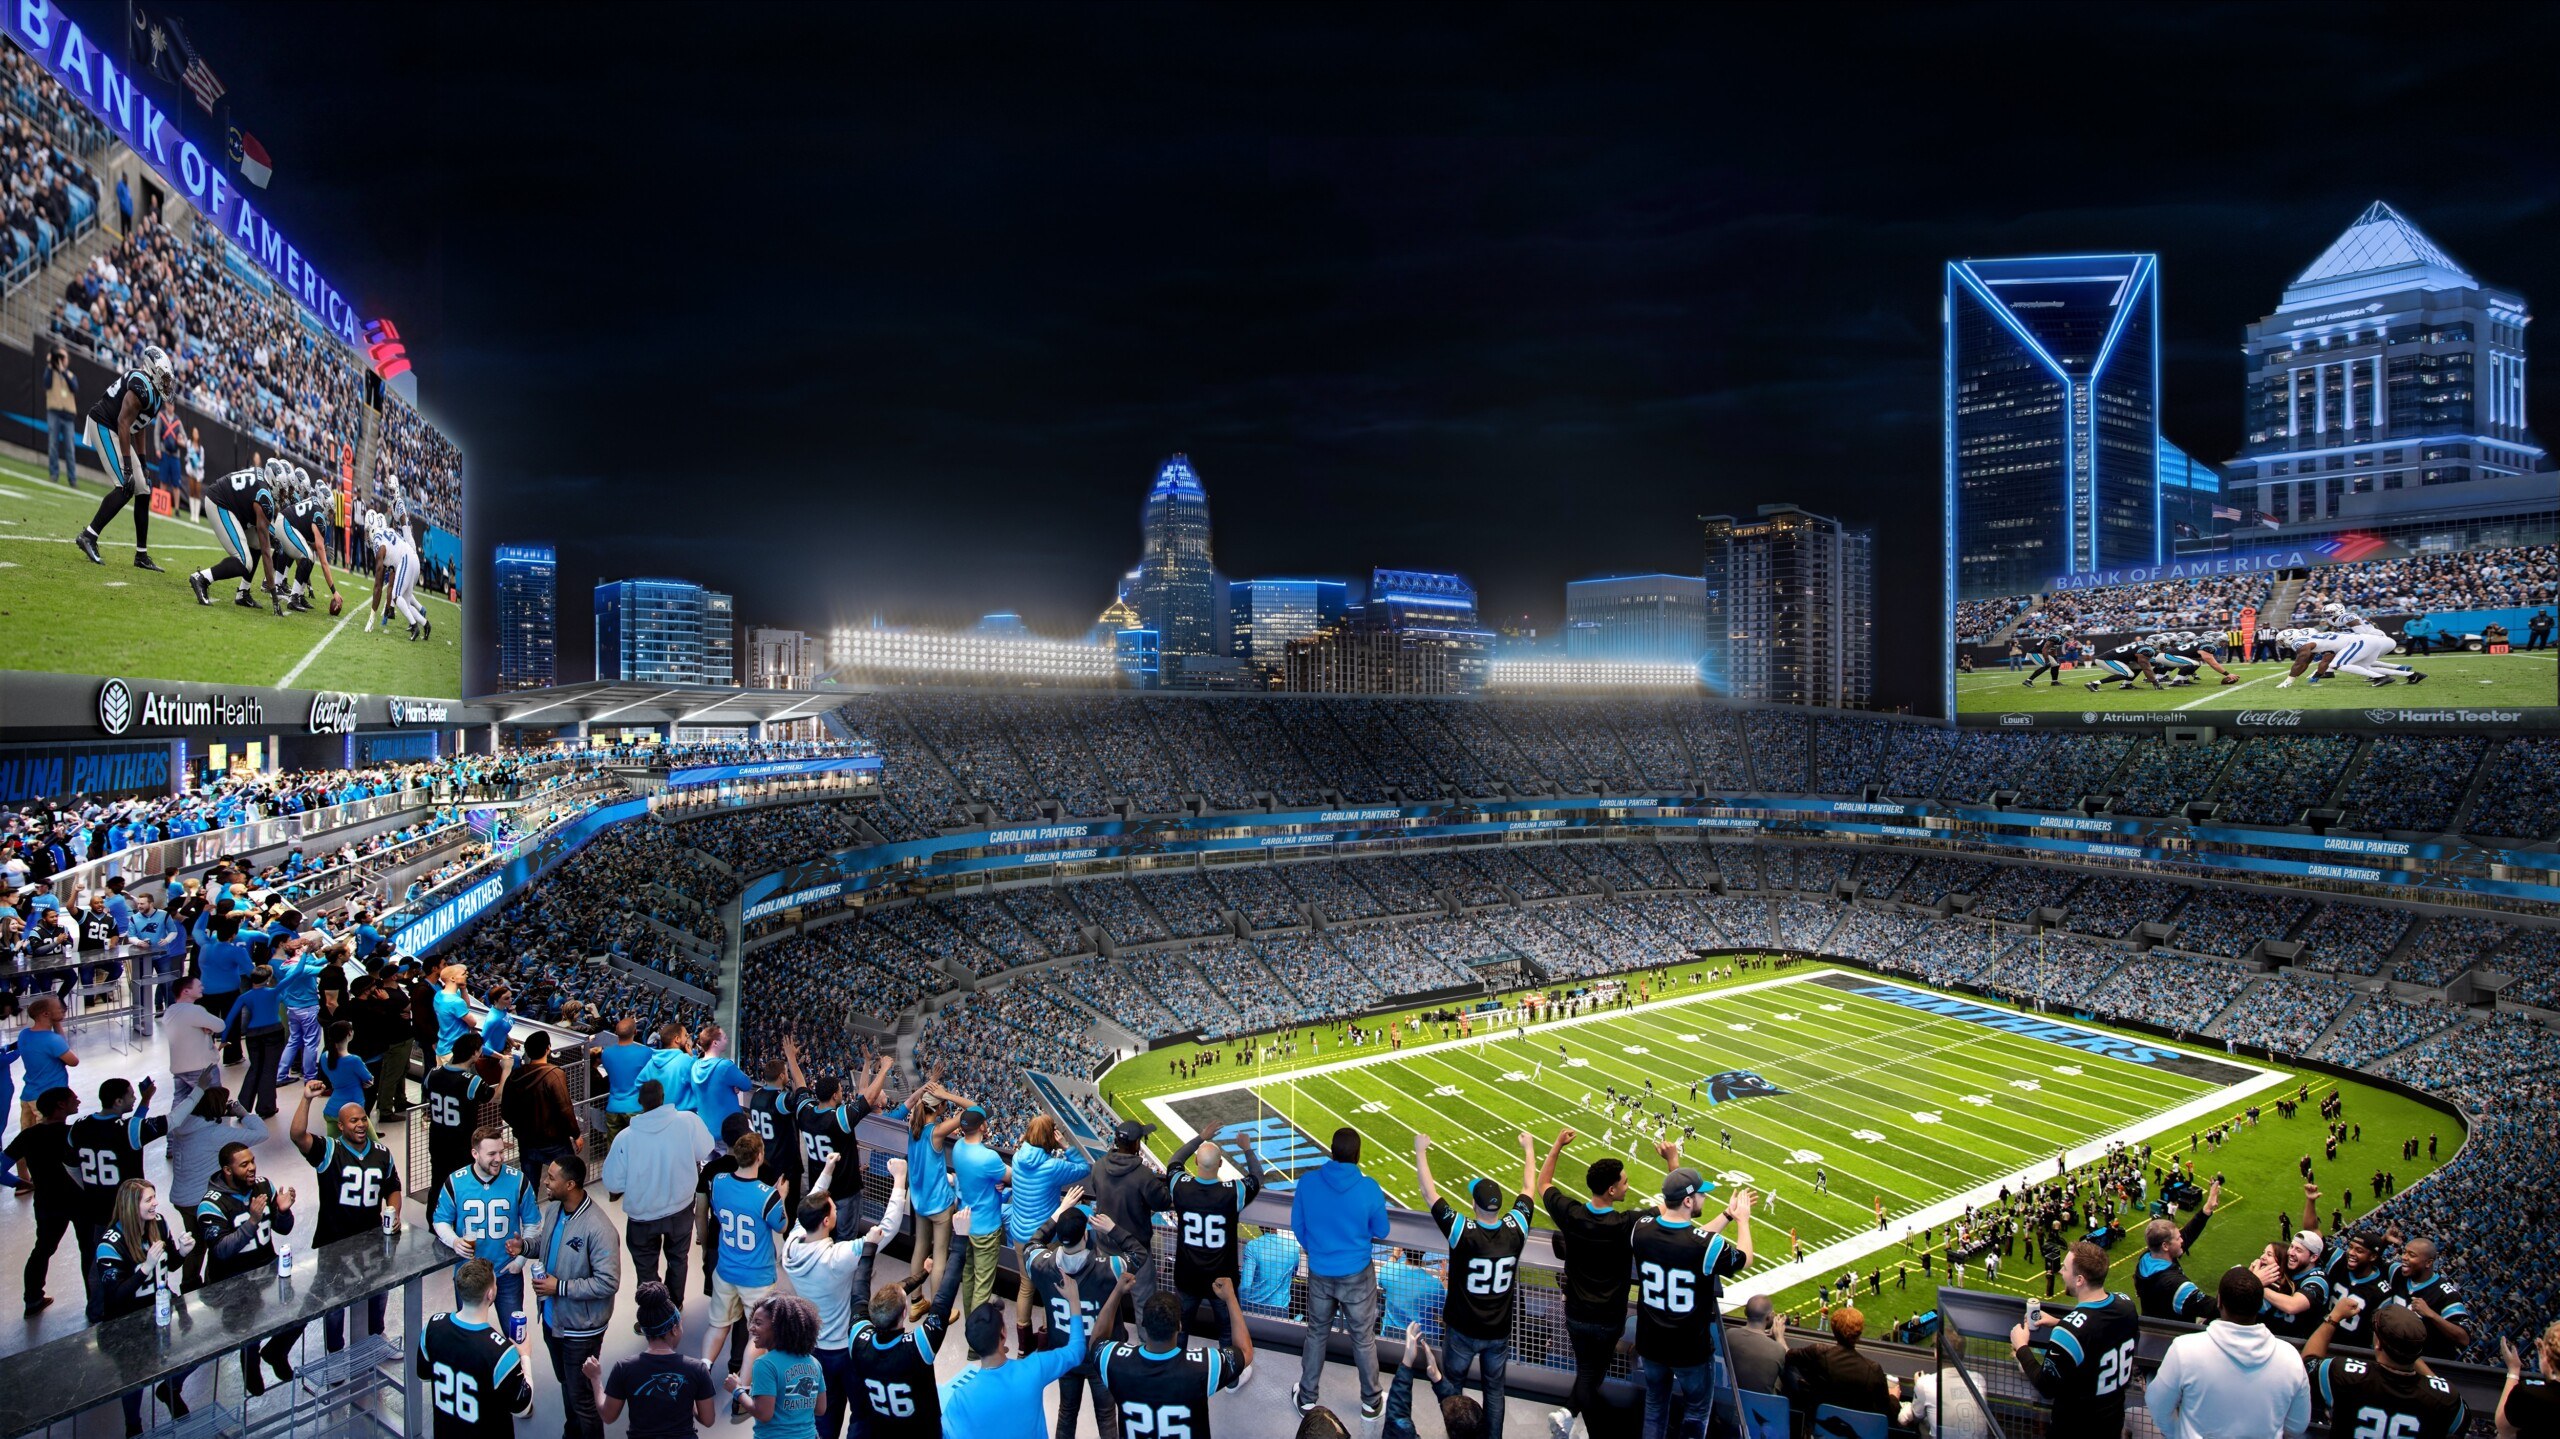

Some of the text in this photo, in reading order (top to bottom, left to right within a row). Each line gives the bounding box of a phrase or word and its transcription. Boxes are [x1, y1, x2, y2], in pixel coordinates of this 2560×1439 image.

[20, 0, 355, 346] BANK OF AMERICA
[154, 496, 168, 511] 30
[2056, 551, 2305, 591] BANK OF AMERICA
[142, 692, 263, 725] Atrium Health
[404, 701, 448, 722] Harris Teeter
[2103, 712, 2187, 722] Atrium Health
[2399, 709, 2521, 722] Harris Teeter
[71, 750, 168, 795] PANTHERS
[739, 763, 804, 775] CAROLINA PANTHERS
[1320, 809, 1400, 821] CAROLINA PANTHERS
[1833, 802, 1904, 814] CAROLINA PANTHERS
[990, 826, 1088, 843] CAROLINA PANTHERS
[2040, 817, 2111, 831] CAROLINA PANTHERS
[1261, 834, 1334, 845] CAROLINA PANTHERS
[2324, 838, 2409, 855] CAROLINA PANTHERS
[1024, 849, 1097, 863] CAROLINA PANTHERS
[2308, 865, 2380, 881] CAROLINA PANTHERS
[396, 875, 503, 955] CAROLINA PANTHERS
[743, 883, 842, 921] CAROLINA PANTHERS
[88, 921, 109, 939] 26
[1850, 986, 2180, 1062] PANTHERS
[430, 1092, 461, 1127] 26
[1360, 1100, 1391, 1113] 10
[802, 1132, 834, 1162] 26
[79, 1148, 120, 1185] 26
[1716, 1170, 1755, 1187] 30
[204, 1190, 221, 1201] 26
[339, 1165, 383, 1207] 26
[463, 1199, 510, 1239] 26
[720, 1209, 756, 1251] 26
[1183, 1212, 1227, 1249] 26
[102, 1229, 121, 1243] 26
[1467, 1256, 1517, 1294] 26
[1641, 1261, 1696, 1313] 26
[2063, 1311, 2087, 1328] 26
[2096, 1338, 2135, 1396] 26
[433, 1361, 479, 1424] 26
[865, 1378, 915, 1417] 26
[1122, 1401, 1191, 1439] 26
